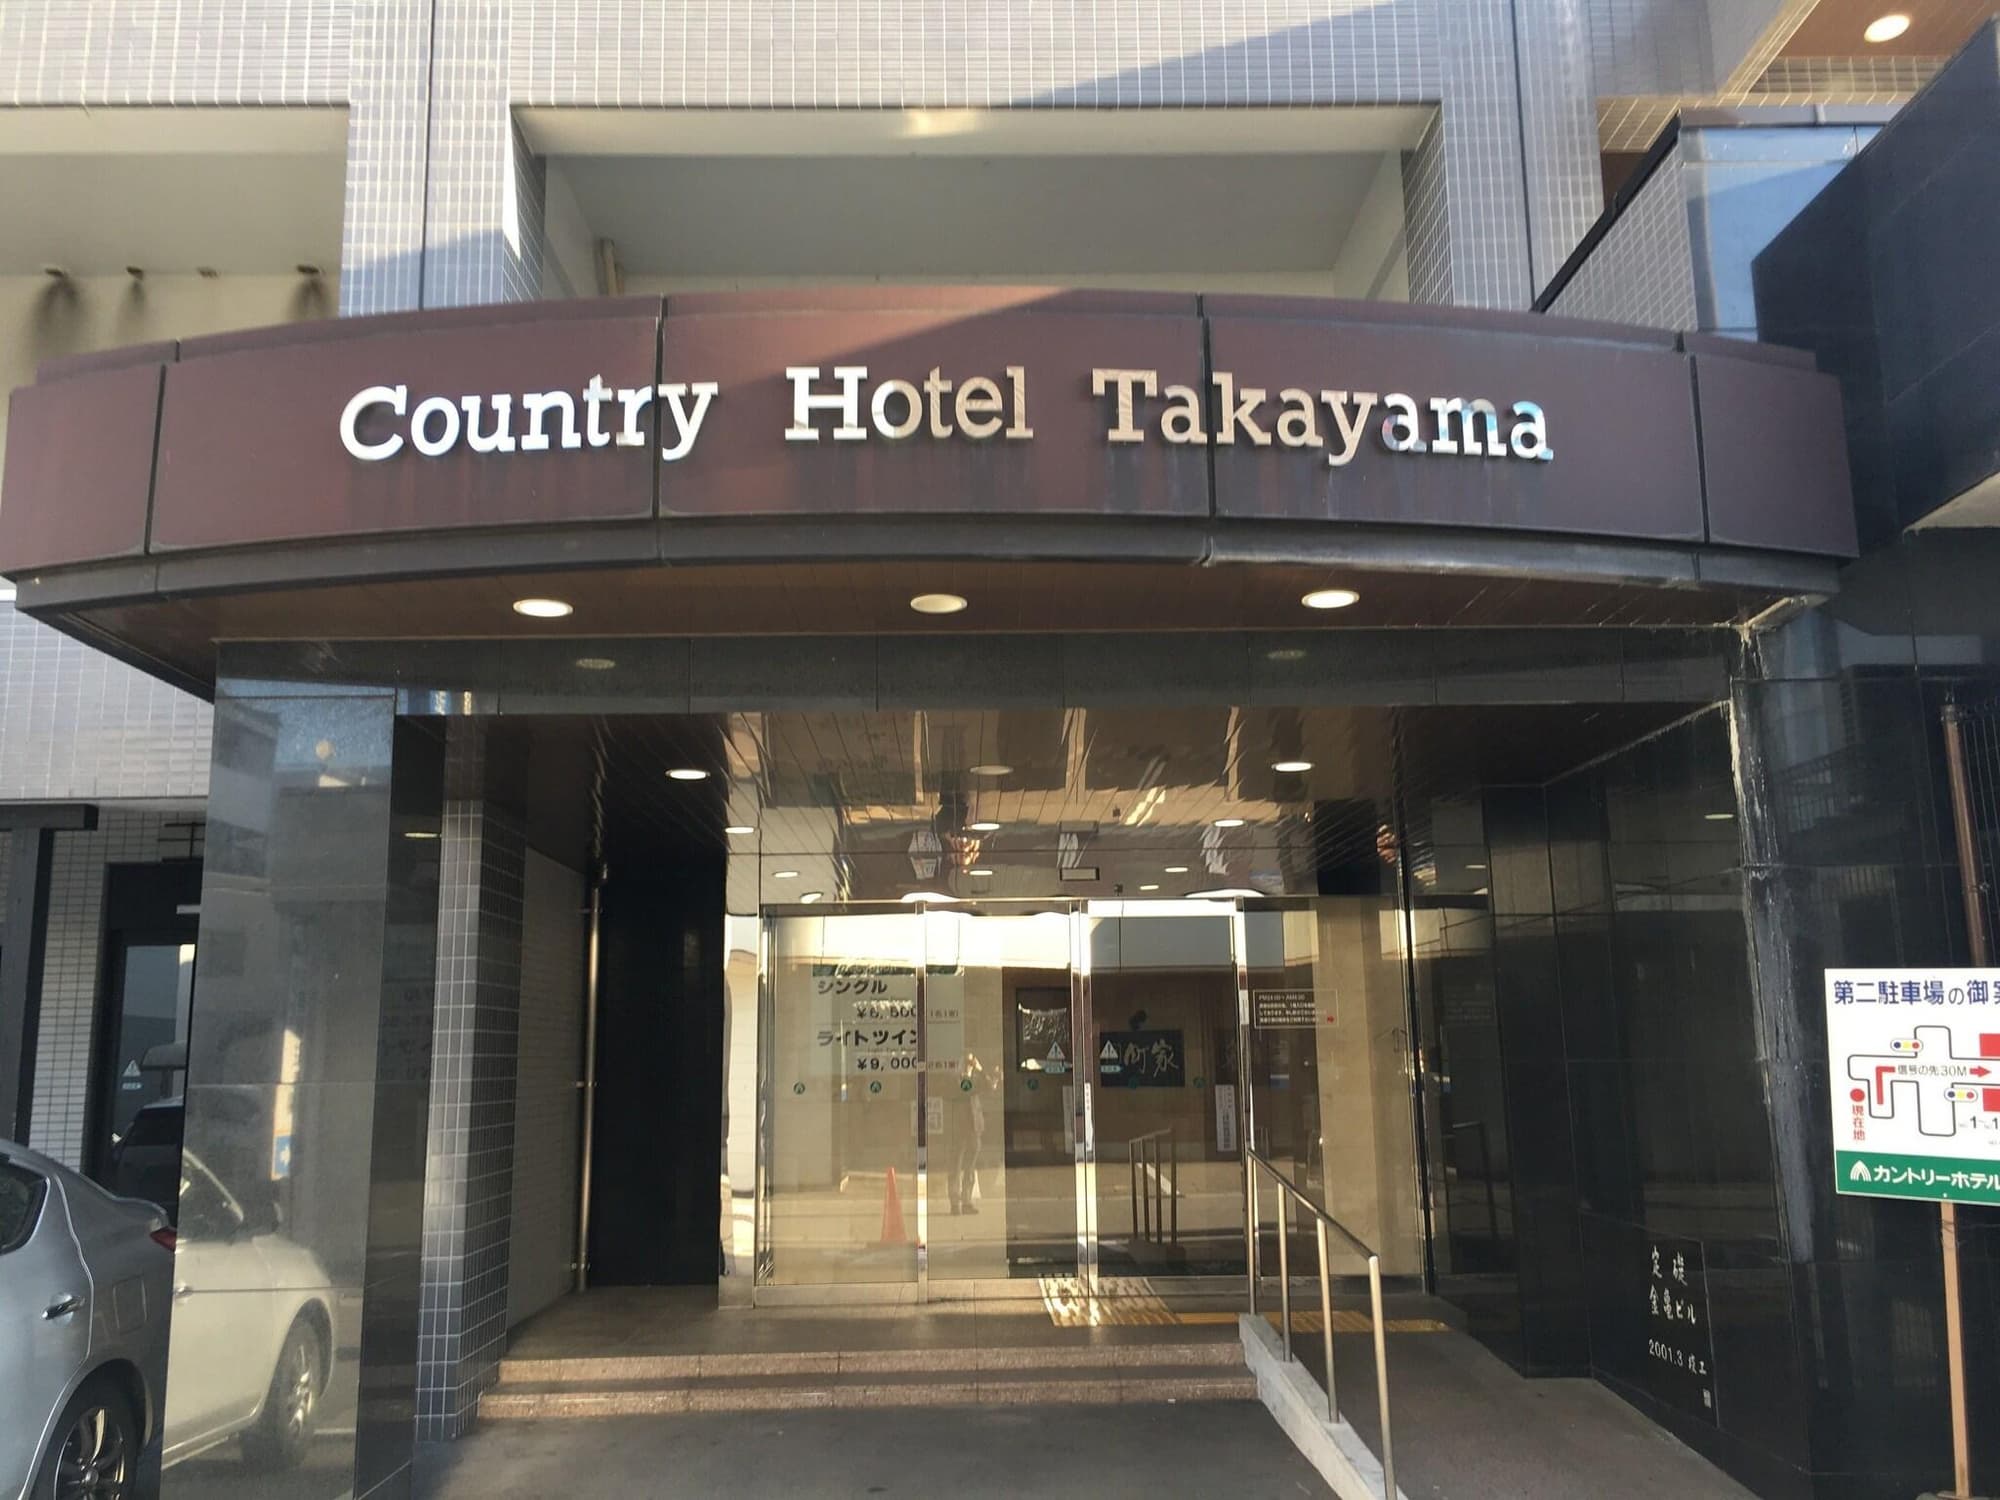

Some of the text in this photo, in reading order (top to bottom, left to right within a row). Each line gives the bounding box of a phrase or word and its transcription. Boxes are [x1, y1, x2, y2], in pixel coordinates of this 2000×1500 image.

[340, 366, 1555, 467] Country Hotel Takayama
[818, 979, 887, 994] シングル
[1873, 1165, 2000, 1191] カントリーホテル
[1649, 1339, 1683, 1367] 2001.3
